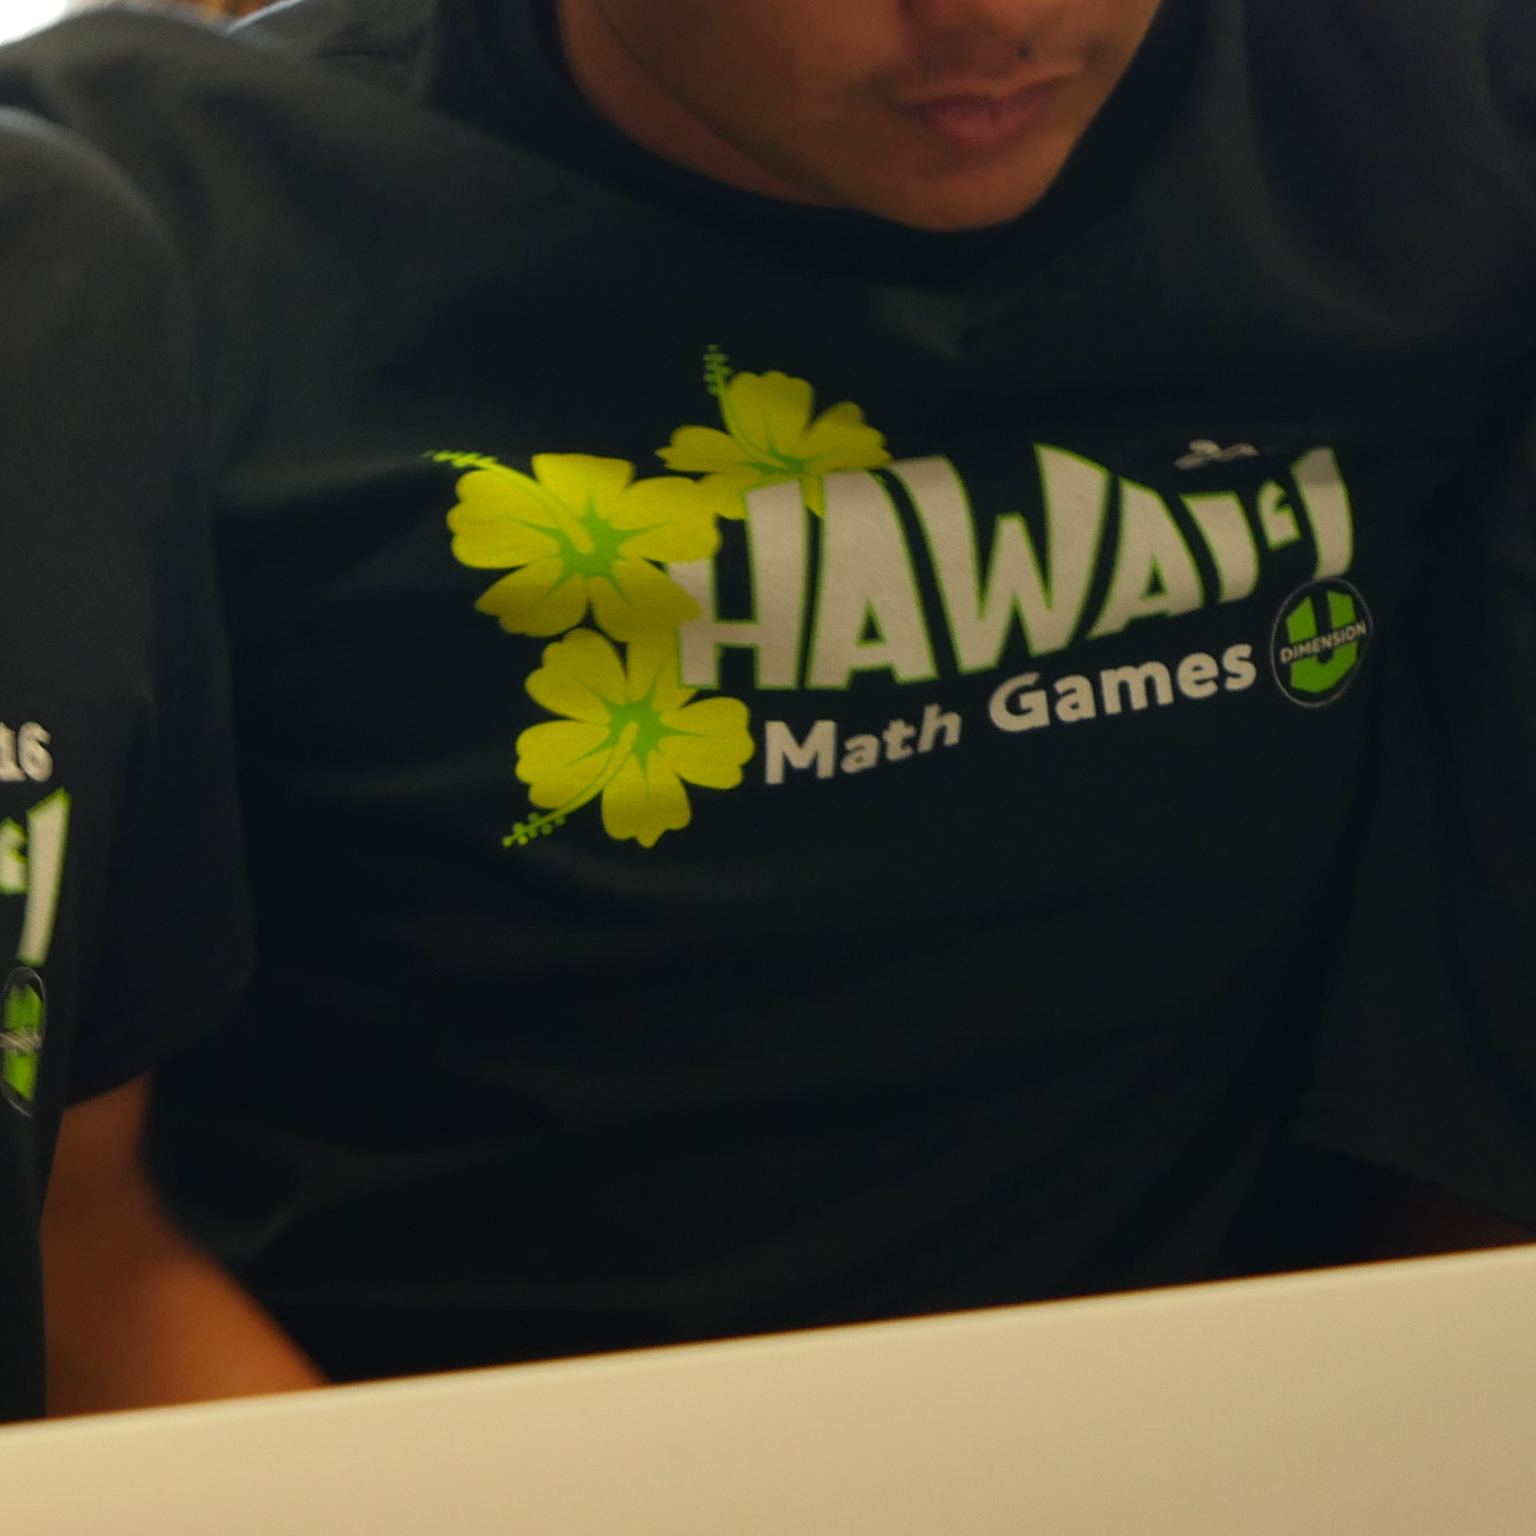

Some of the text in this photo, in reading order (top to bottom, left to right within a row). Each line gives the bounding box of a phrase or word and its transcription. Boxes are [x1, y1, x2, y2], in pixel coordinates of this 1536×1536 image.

[1280, 620, 1366, 663] DIMENSION
[764, 643, 1257, 786] Math Games
